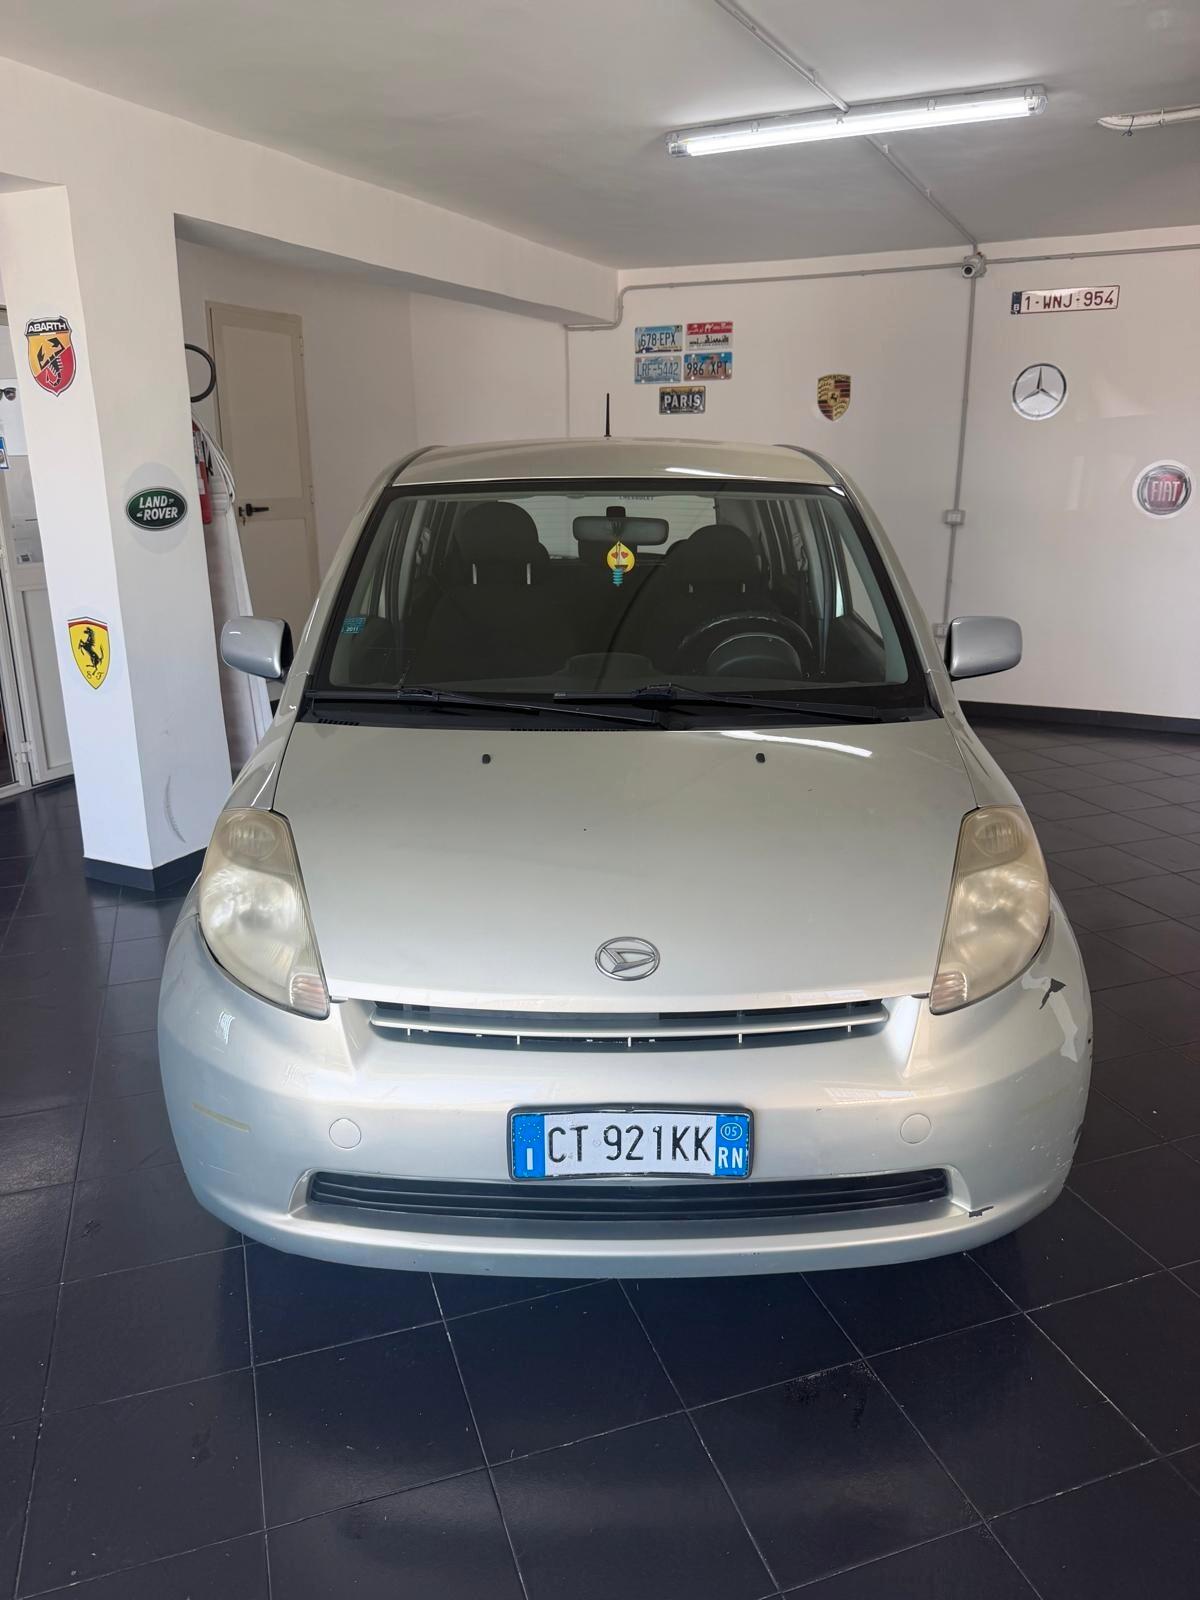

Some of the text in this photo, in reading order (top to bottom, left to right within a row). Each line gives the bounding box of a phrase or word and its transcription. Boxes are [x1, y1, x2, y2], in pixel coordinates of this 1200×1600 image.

[28, 322, 66, 332] ABARTH
[686, 360, 728, 377] 986 XPT
[664, 394, 702, 407] PARIS
[1151, 480, 1181, 502] FIAT
[723, 1127, 739, 1137] 05
[548, 1125, 589, 1163] CT
[603, 1124, 713, 1162] 921KK
[718, 1147, 743, 1169] RN
